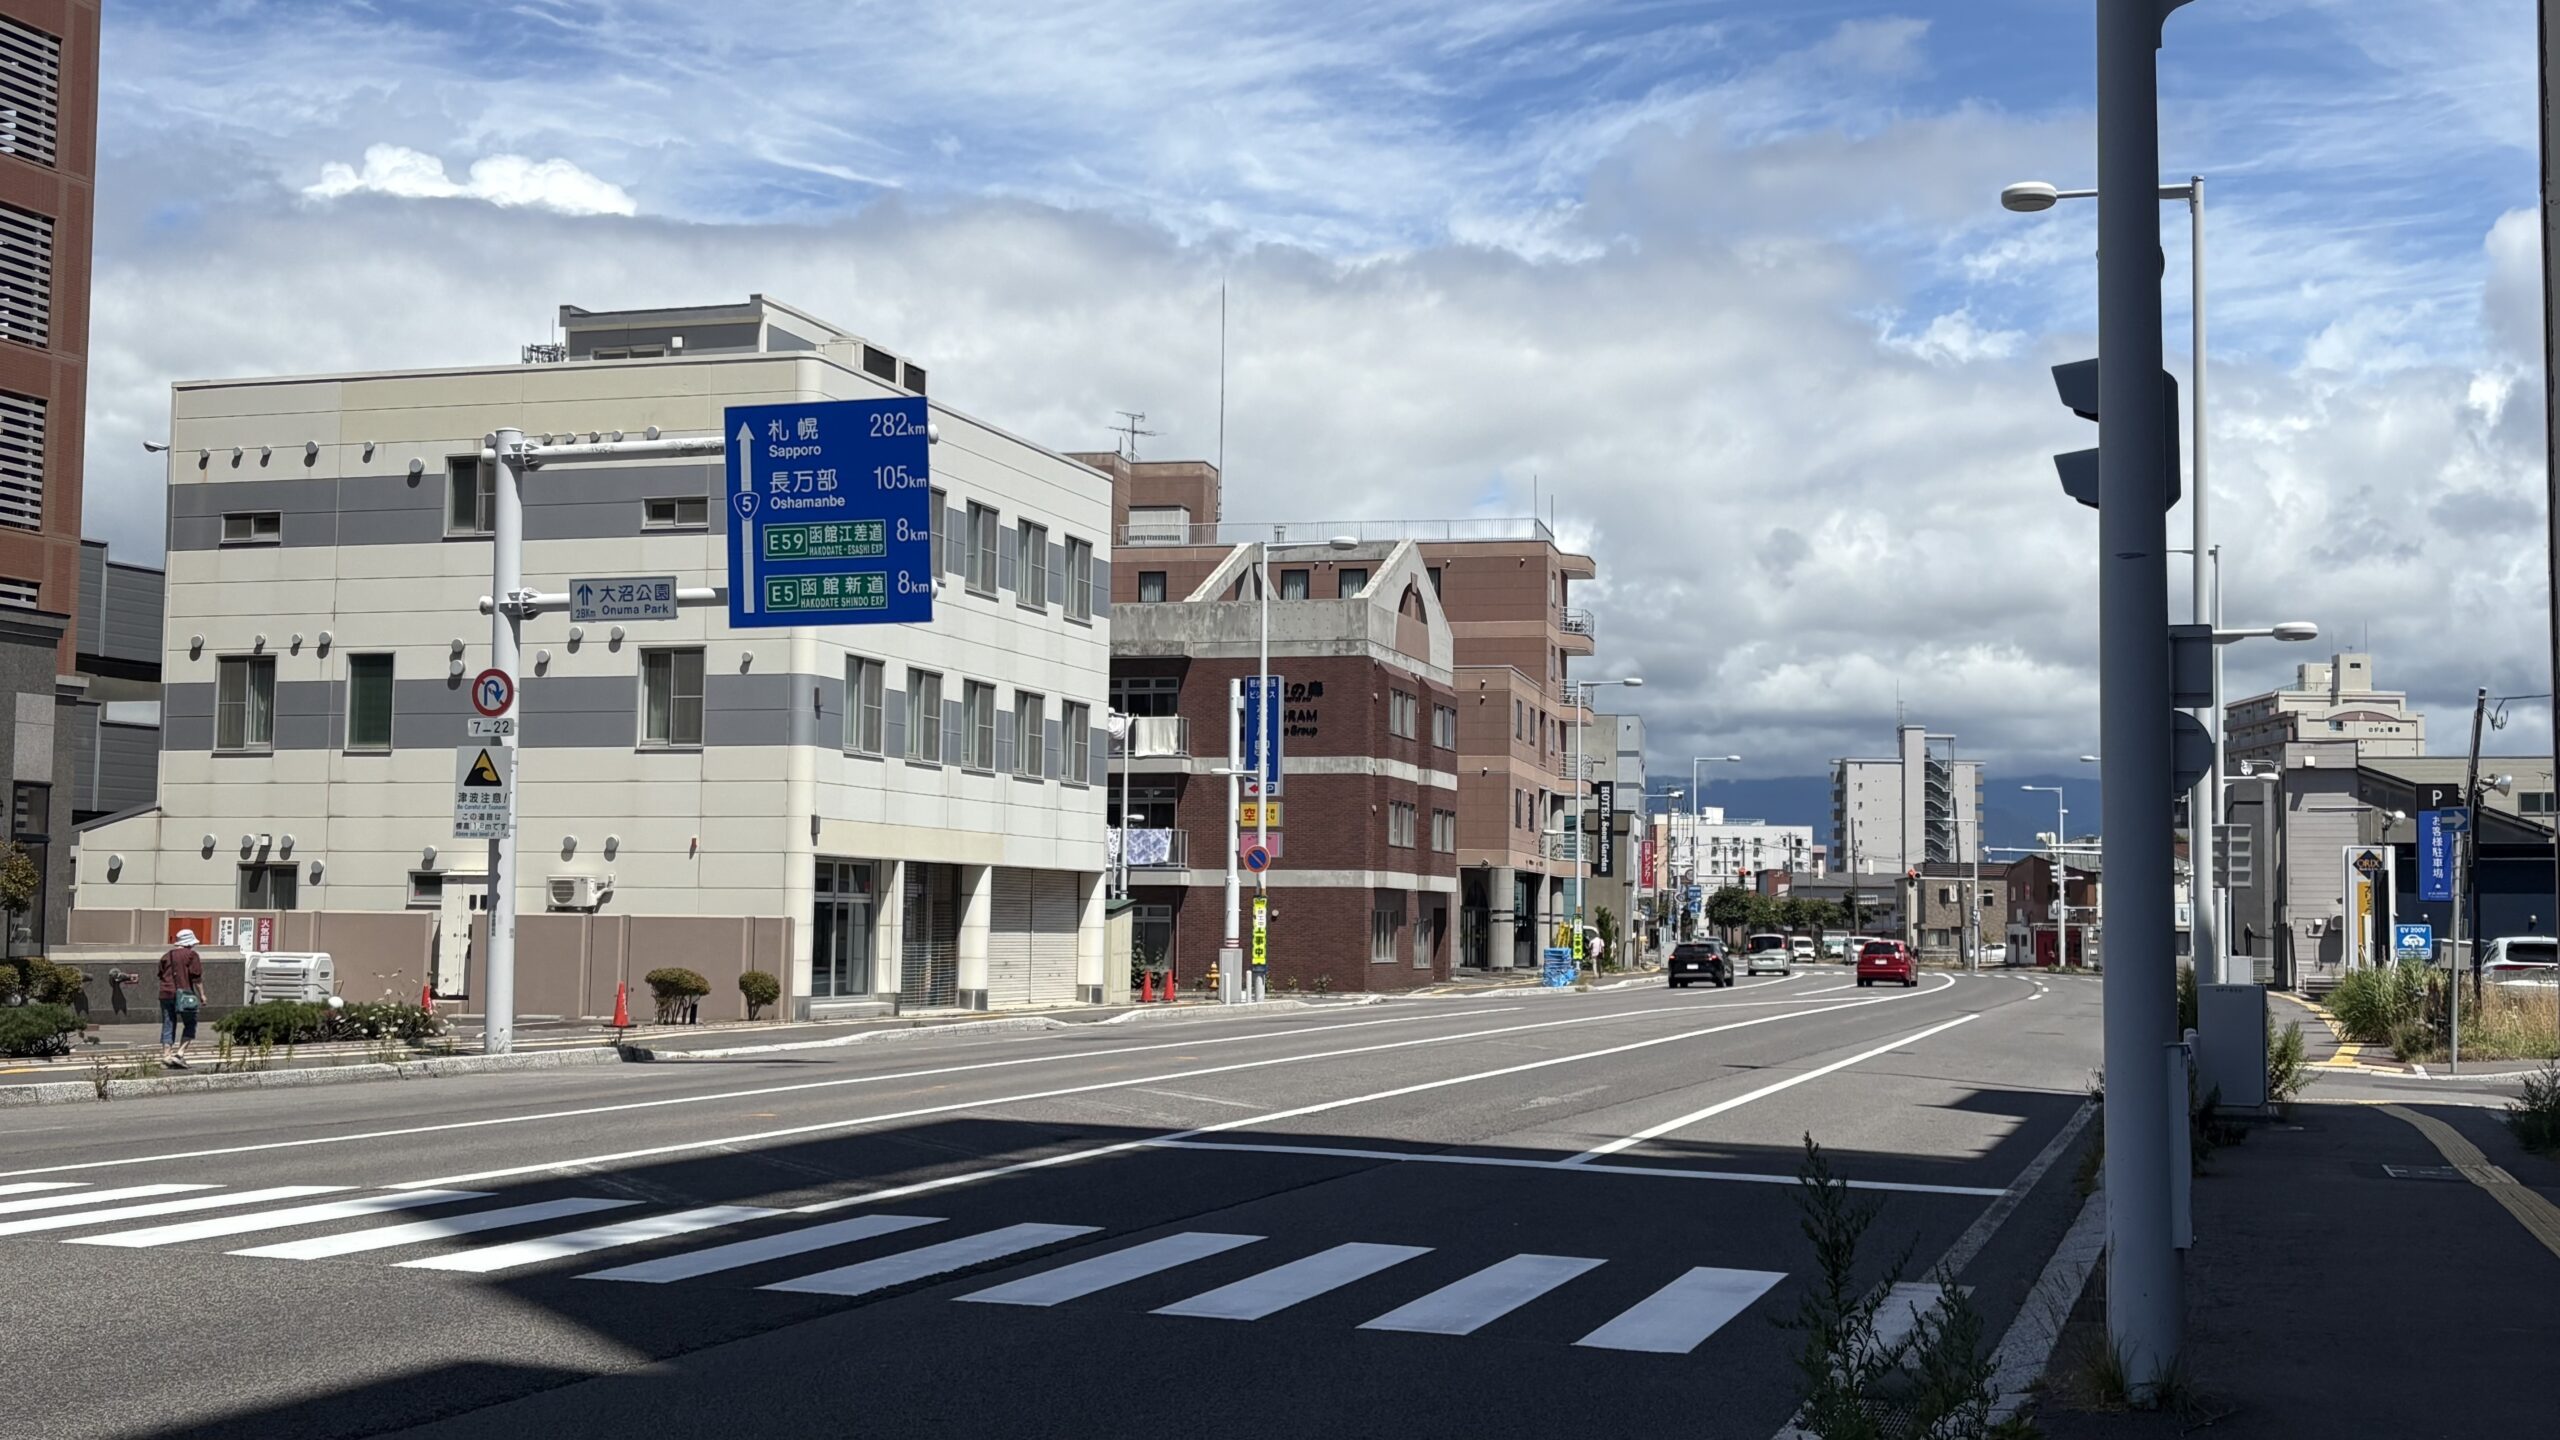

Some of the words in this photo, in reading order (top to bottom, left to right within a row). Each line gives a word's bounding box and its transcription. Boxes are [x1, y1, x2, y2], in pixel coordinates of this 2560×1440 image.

[768, 417, 819, 442] 札幌
[870, 412, 926, 437] 282km
[769, 444, 822, 460] Sapporo
[769, 468, 838, 494] 長万部
[873, 465, 927, 489] 105km
[742, 496, 752, 512] 5
[770, 495, 845, 510] Oshamanbe
[770, 533, 804, 550] E59
[809, 524, 883, 544] 函館江差道
[896, 518, 928, 542] 8km
[871, 544, 883, 554] EXP
[600, 584, 670, 603] 大沼公園
[772, 586, 794, 602] E5
[800, 576, 884, 596] 函館新道
[898, 570, 929, 594] 8km
[602, 605, 640, 615] Onuma
[644, 603, 669, 614] Park
[800, 599, 839, 609] HAKODATE
[841, 596, 869, 607] SHINDO
[871, 596, 884, 606] EXP
[1601, 786, 1611, 820] HOTEL
[2432, 789, 2443, 807] P
[1601, 843, 1610, 873] Garden
